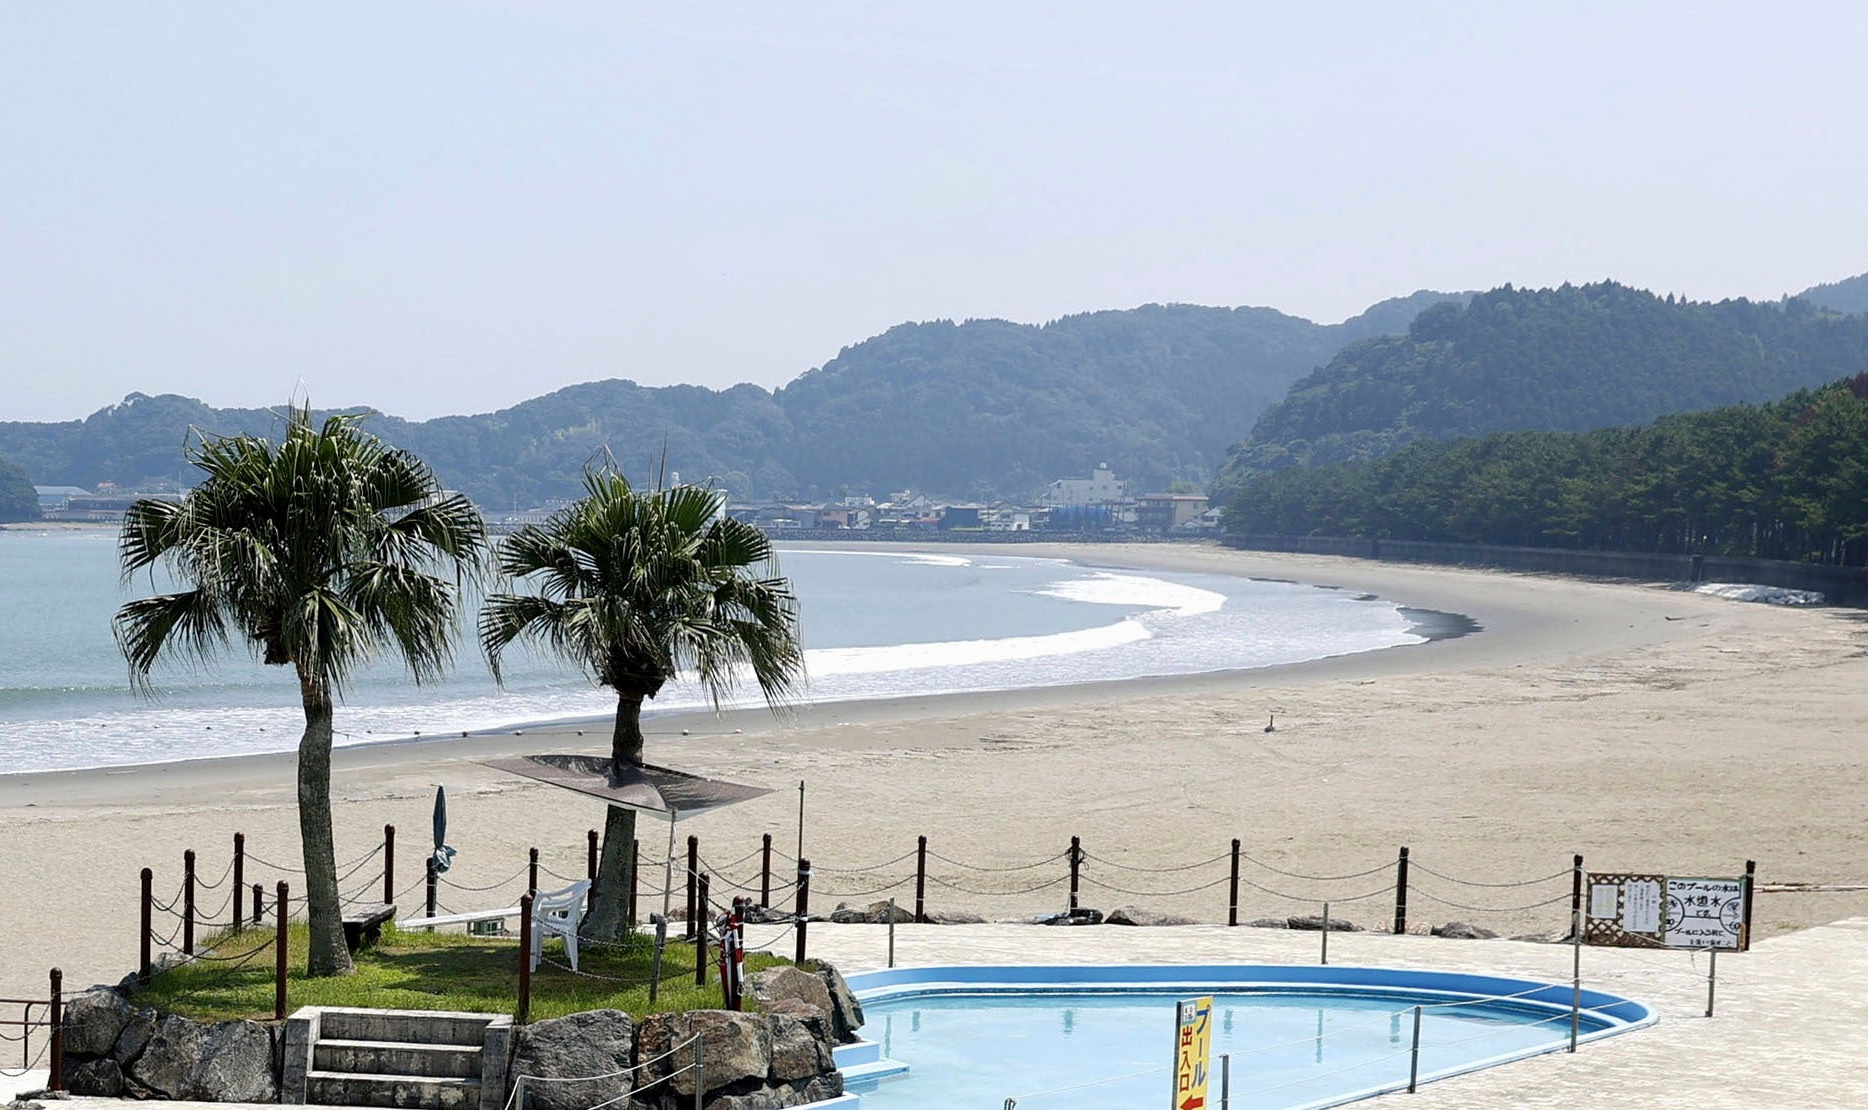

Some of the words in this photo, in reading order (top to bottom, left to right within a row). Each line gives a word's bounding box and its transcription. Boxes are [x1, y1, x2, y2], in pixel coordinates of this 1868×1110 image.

[1684, 894, 1721, 908] 水道水
[1179, 1025, 1192, 1092] 出入口
[1191, 1003, 1211, 1088] プール
